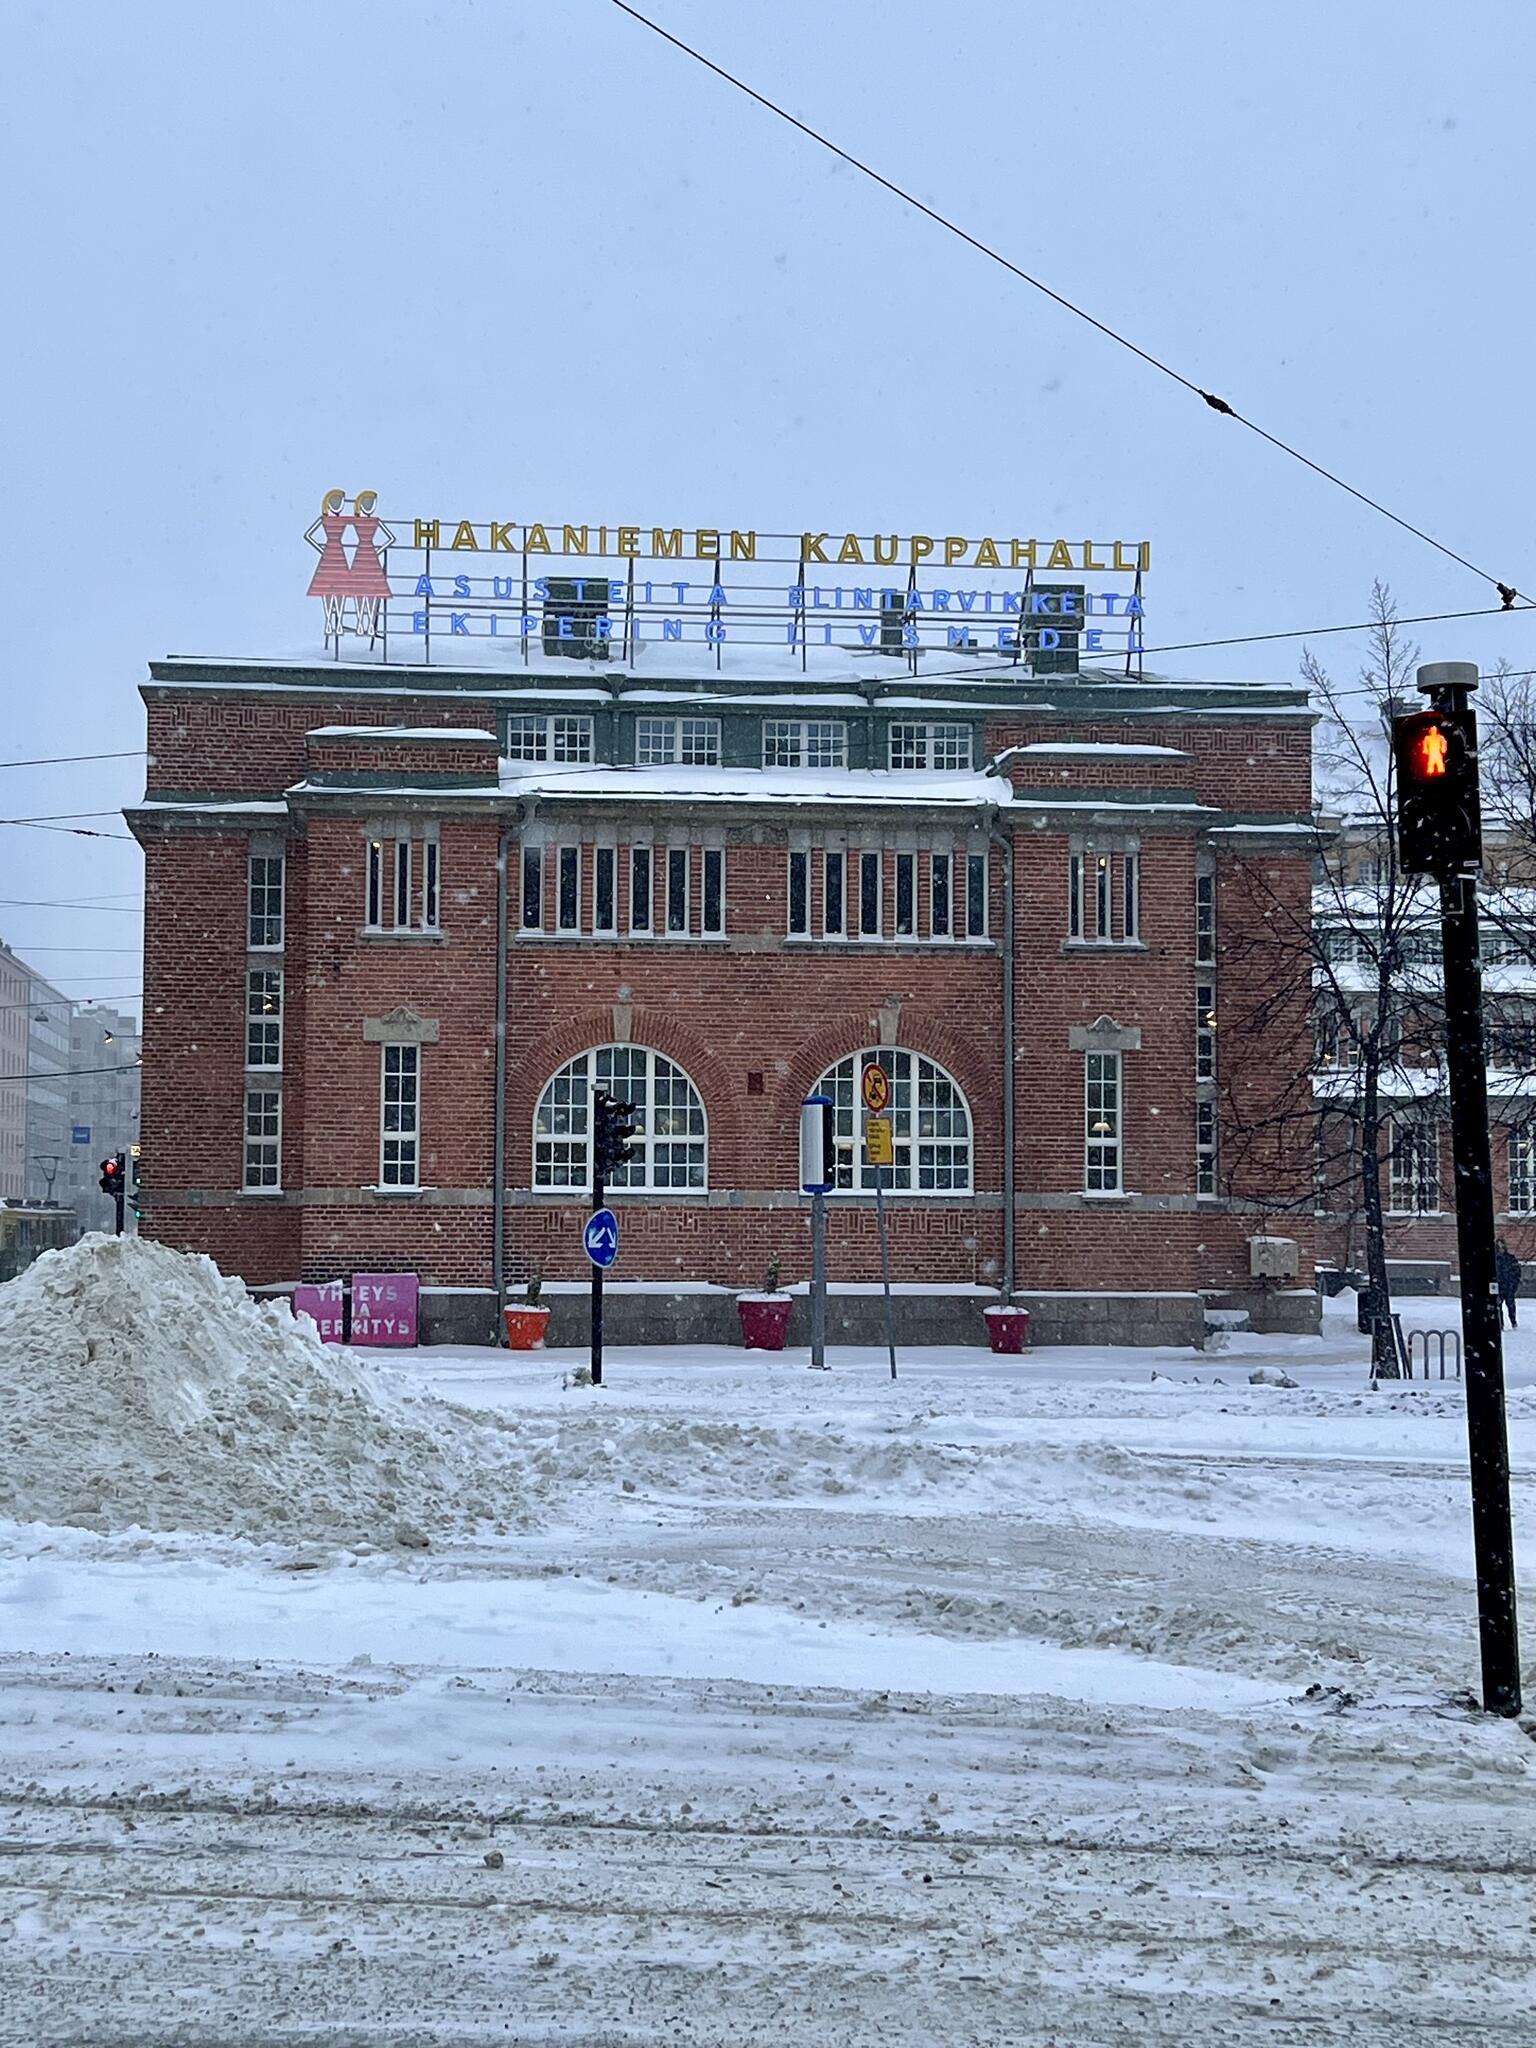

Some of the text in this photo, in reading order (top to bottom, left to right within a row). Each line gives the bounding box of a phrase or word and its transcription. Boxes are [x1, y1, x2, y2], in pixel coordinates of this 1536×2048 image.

[414, 518, 1151, 571] HAKANIEMEN KAUPPAHALLI
[414, 574, 728, 606] ASUSTEITA
[788, 584, 1145, 616] ELINTARVIKKEITA
[412, 611, 727, 643] EKIPERING
[787, 622, 1145, 652] LIVSMEDEL
[320, 1319, 410, 1336] ERKITYS
